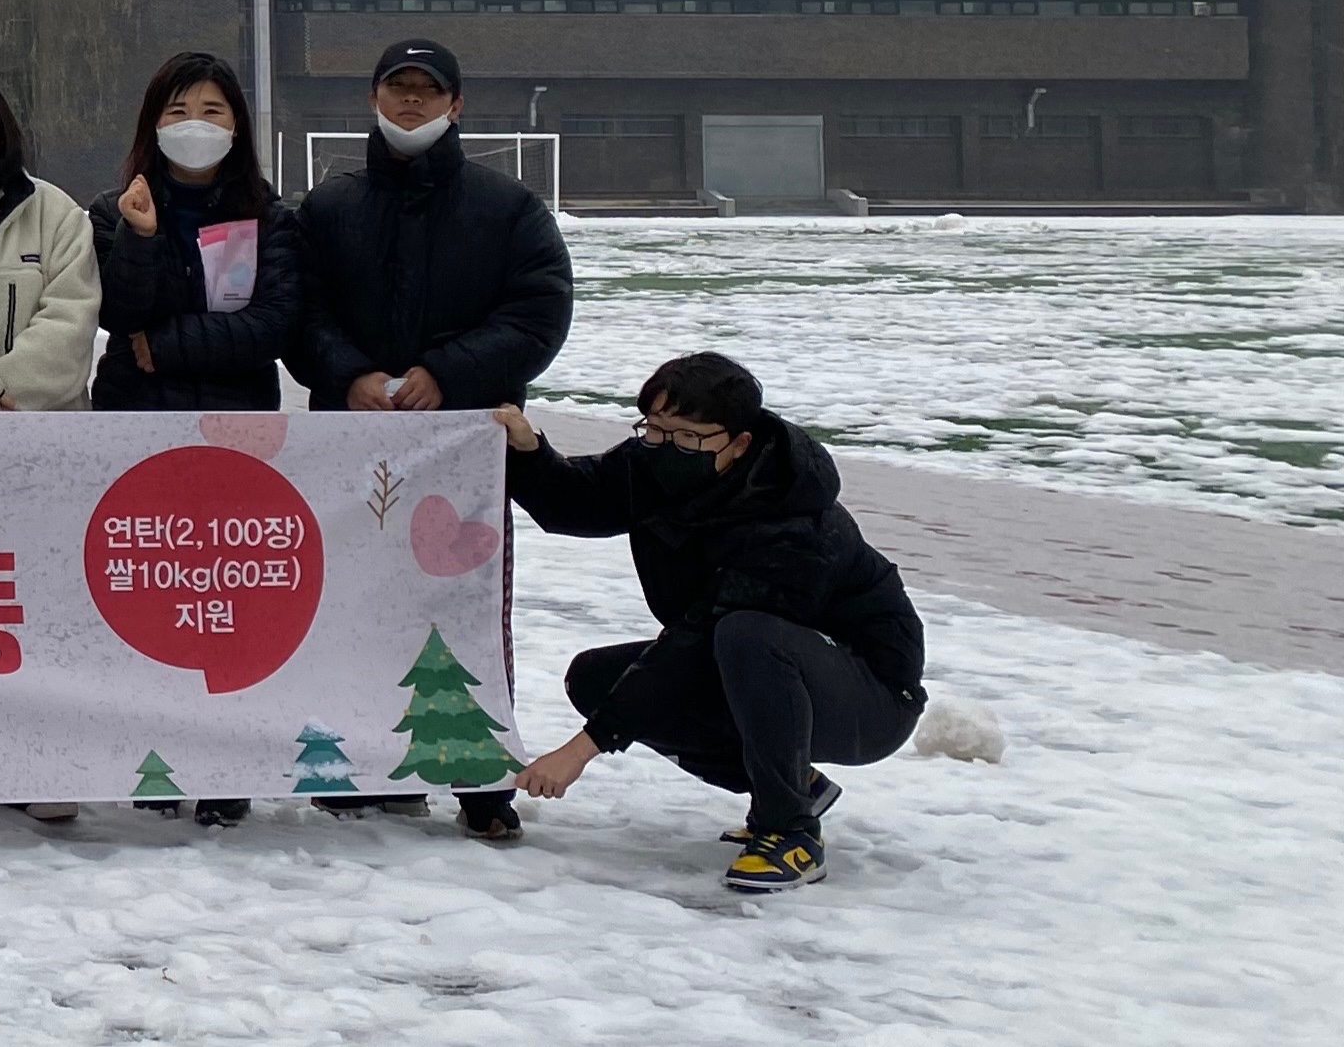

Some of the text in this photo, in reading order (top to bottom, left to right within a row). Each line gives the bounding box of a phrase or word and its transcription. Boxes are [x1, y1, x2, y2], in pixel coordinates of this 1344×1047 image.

[104, 514, 305, 551] 연탄(2,100장)
[104, 556, 302, 594] 쌀10kg(60포)
[175, 600, 235, 634] 지원
